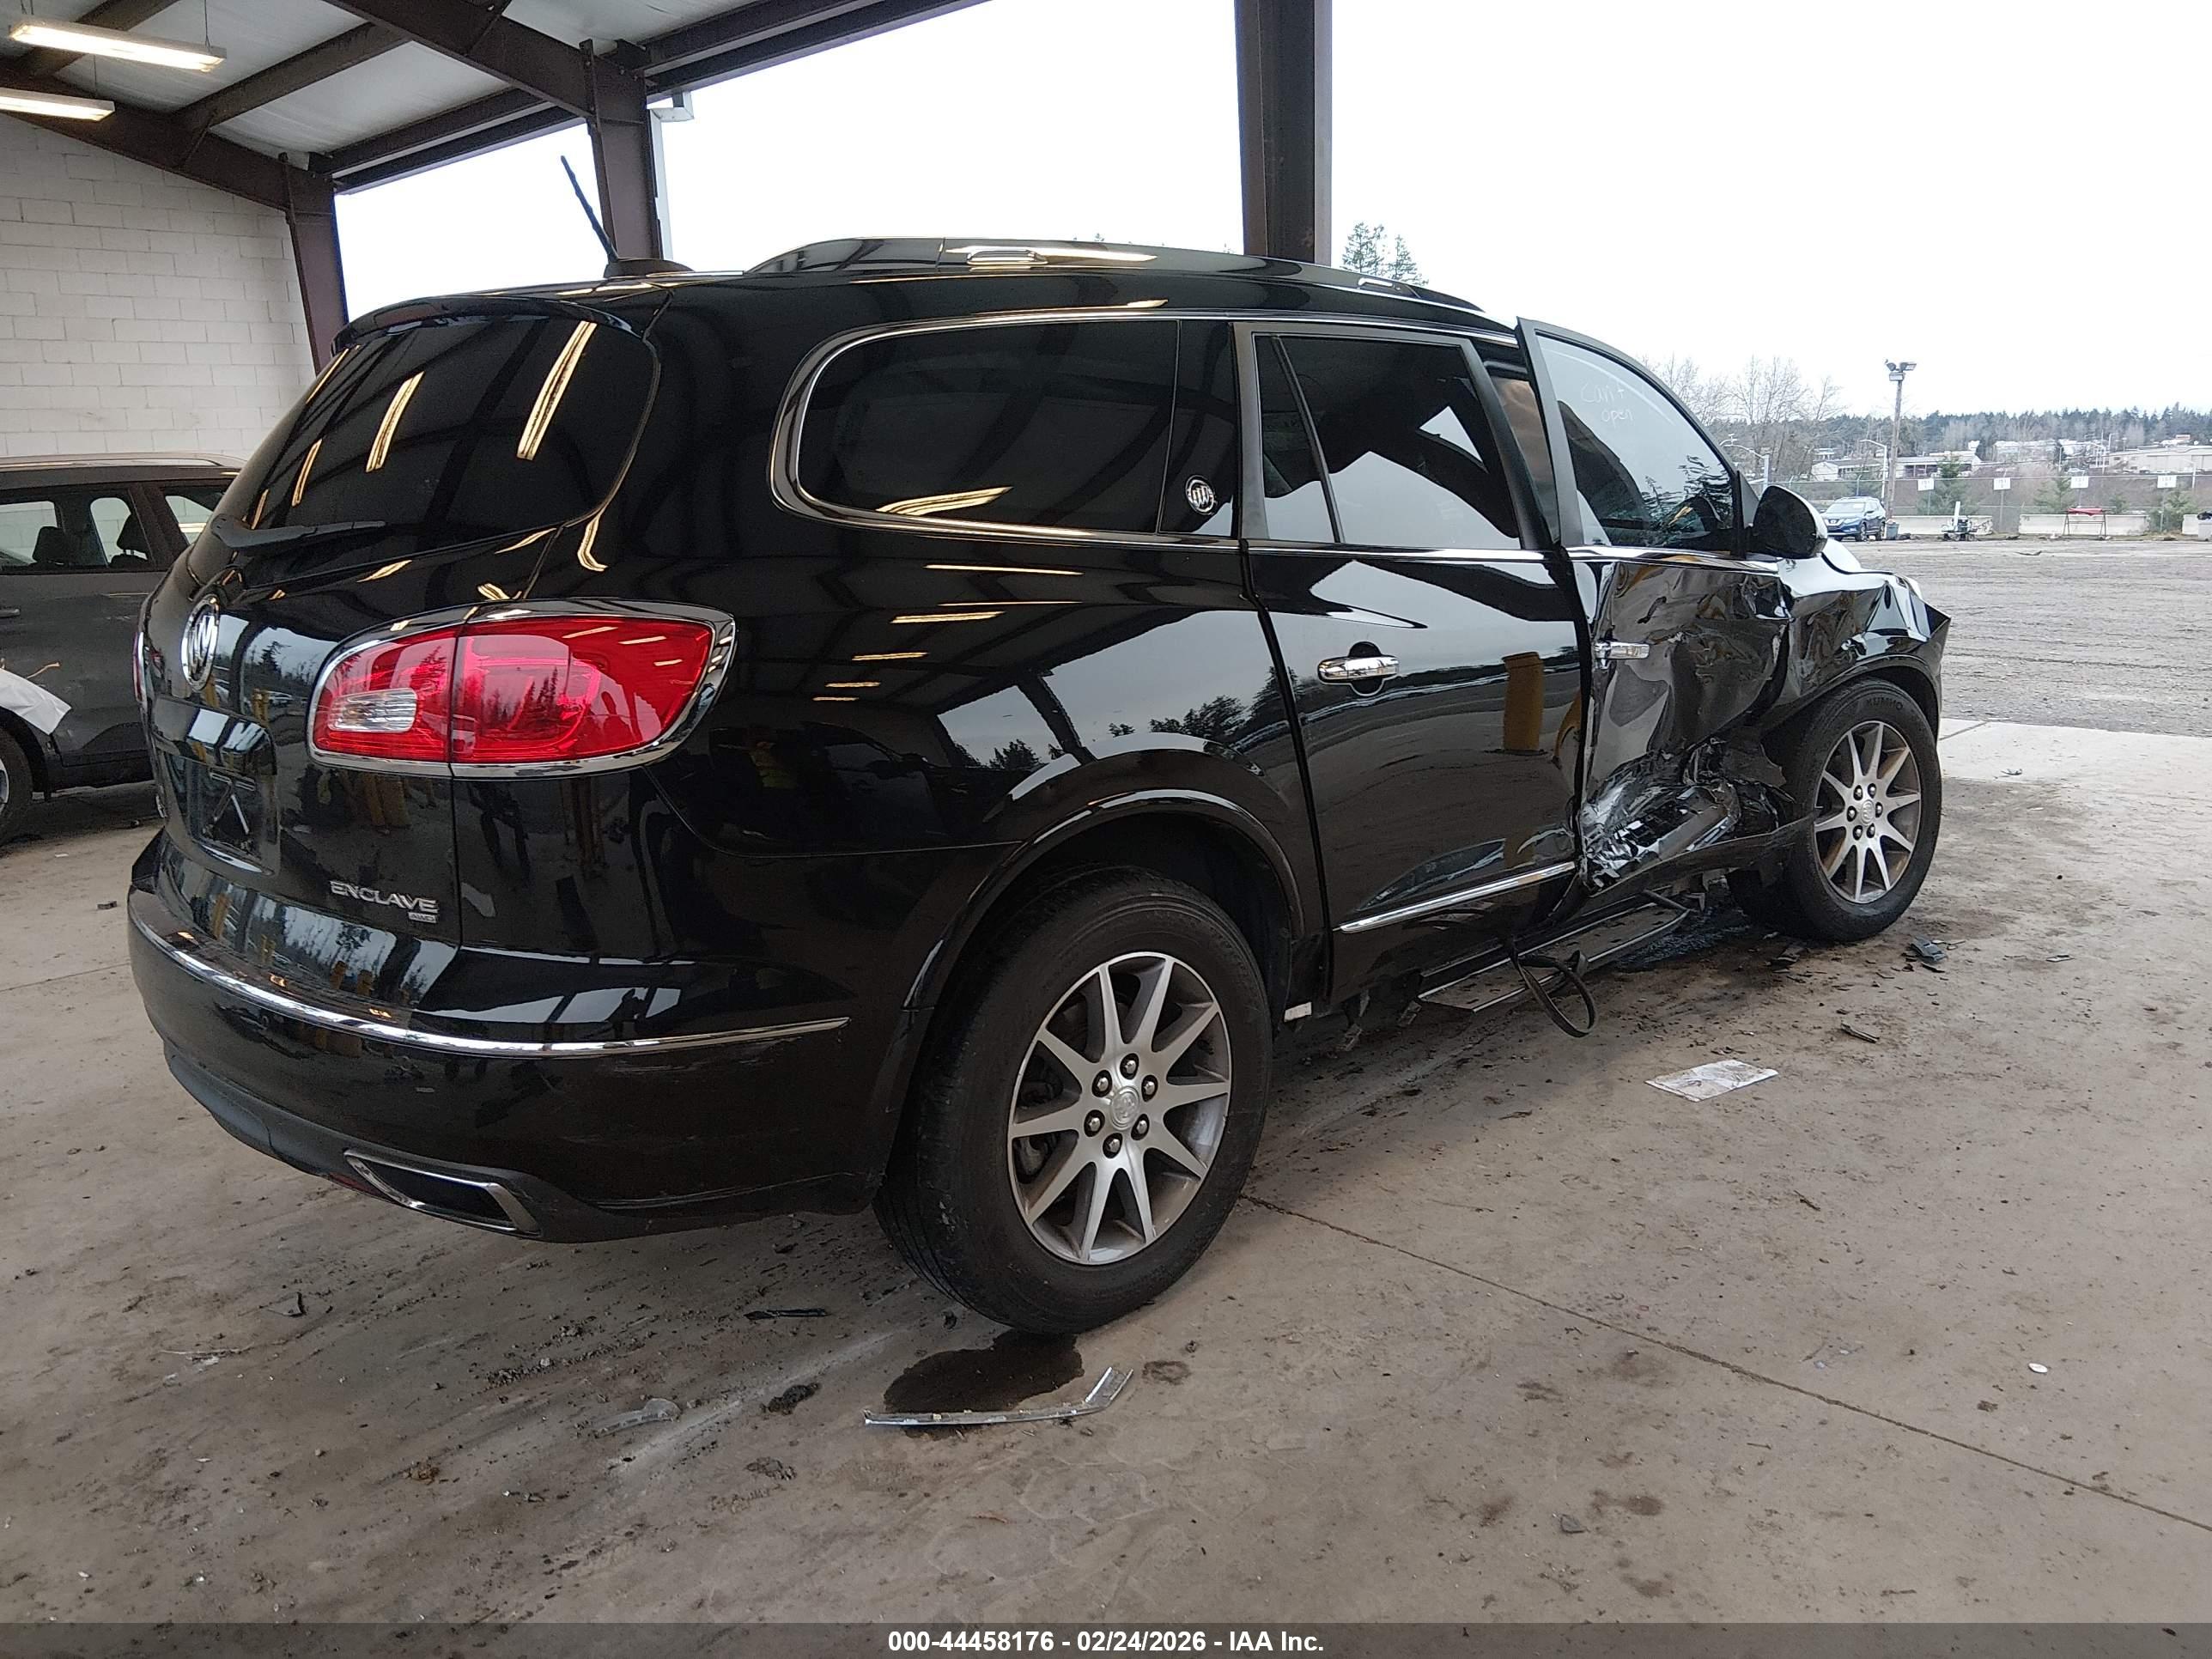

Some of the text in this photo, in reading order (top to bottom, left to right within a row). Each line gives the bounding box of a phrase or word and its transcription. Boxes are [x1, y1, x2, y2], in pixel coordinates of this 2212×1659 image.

[1601, 408, 1633, 428] open
[329, 880, 440, 914] ENCLAVE
[408, 912, 437, 923] AWD
